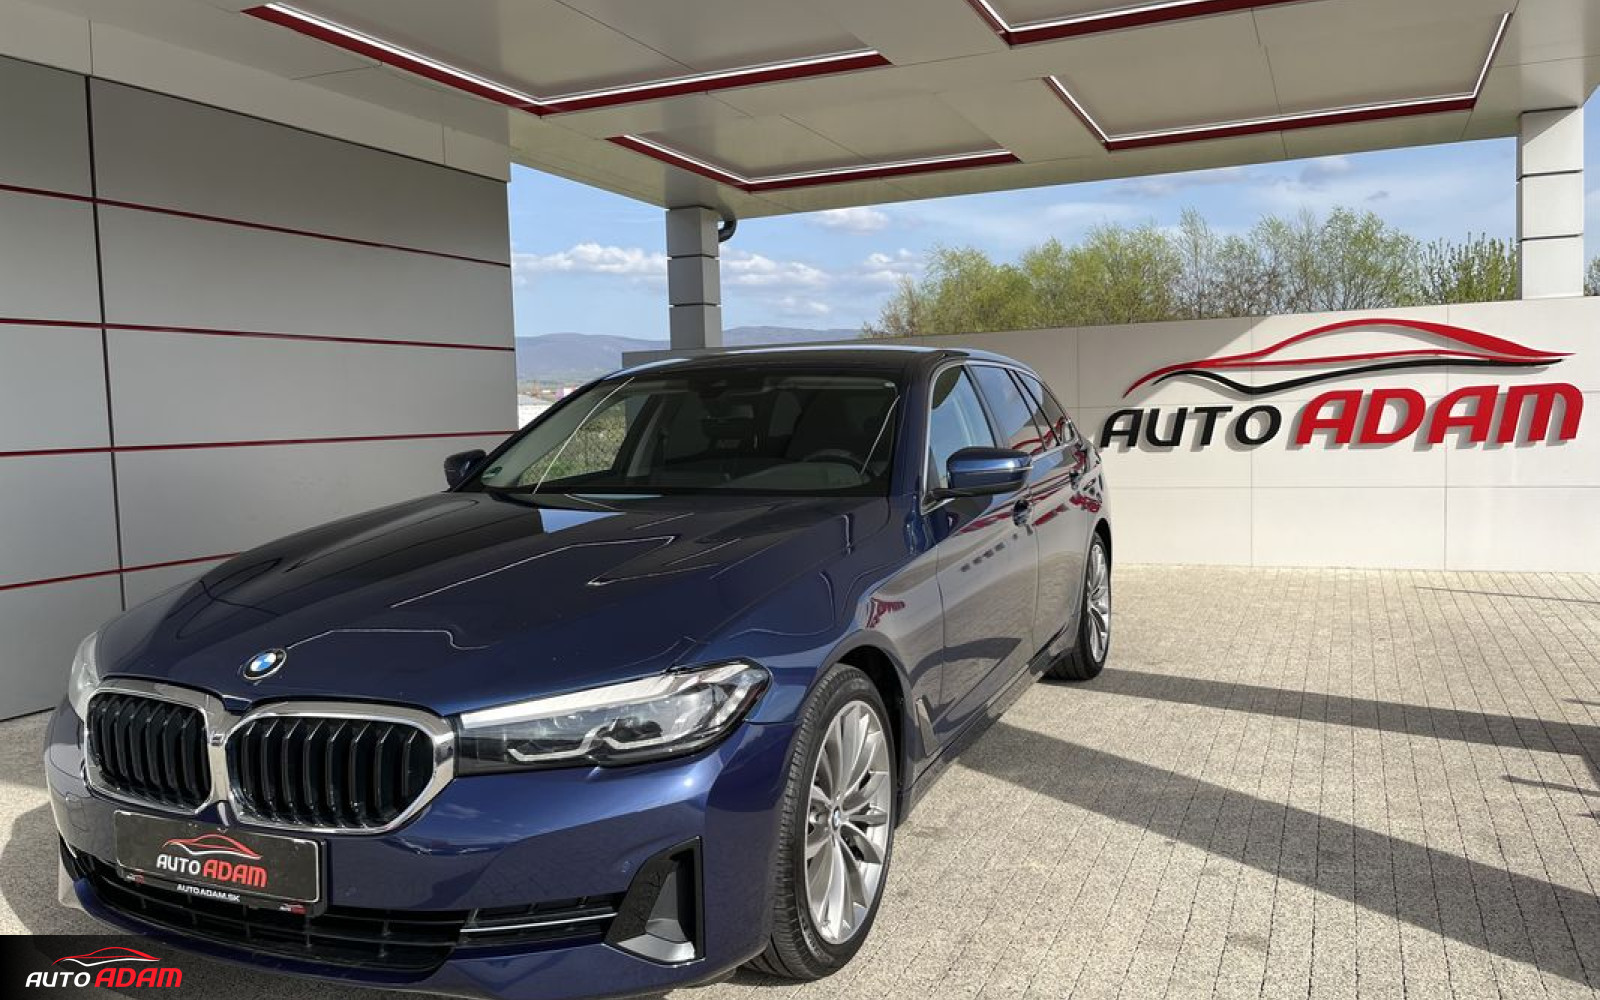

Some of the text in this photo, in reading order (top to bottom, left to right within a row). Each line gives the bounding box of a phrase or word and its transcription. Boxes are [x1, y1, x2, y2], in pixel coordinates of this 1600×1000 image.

[1101, 383, 1584, 447] AUTO ADAM
[156, 853, 268, 888] AUTO ADAM
